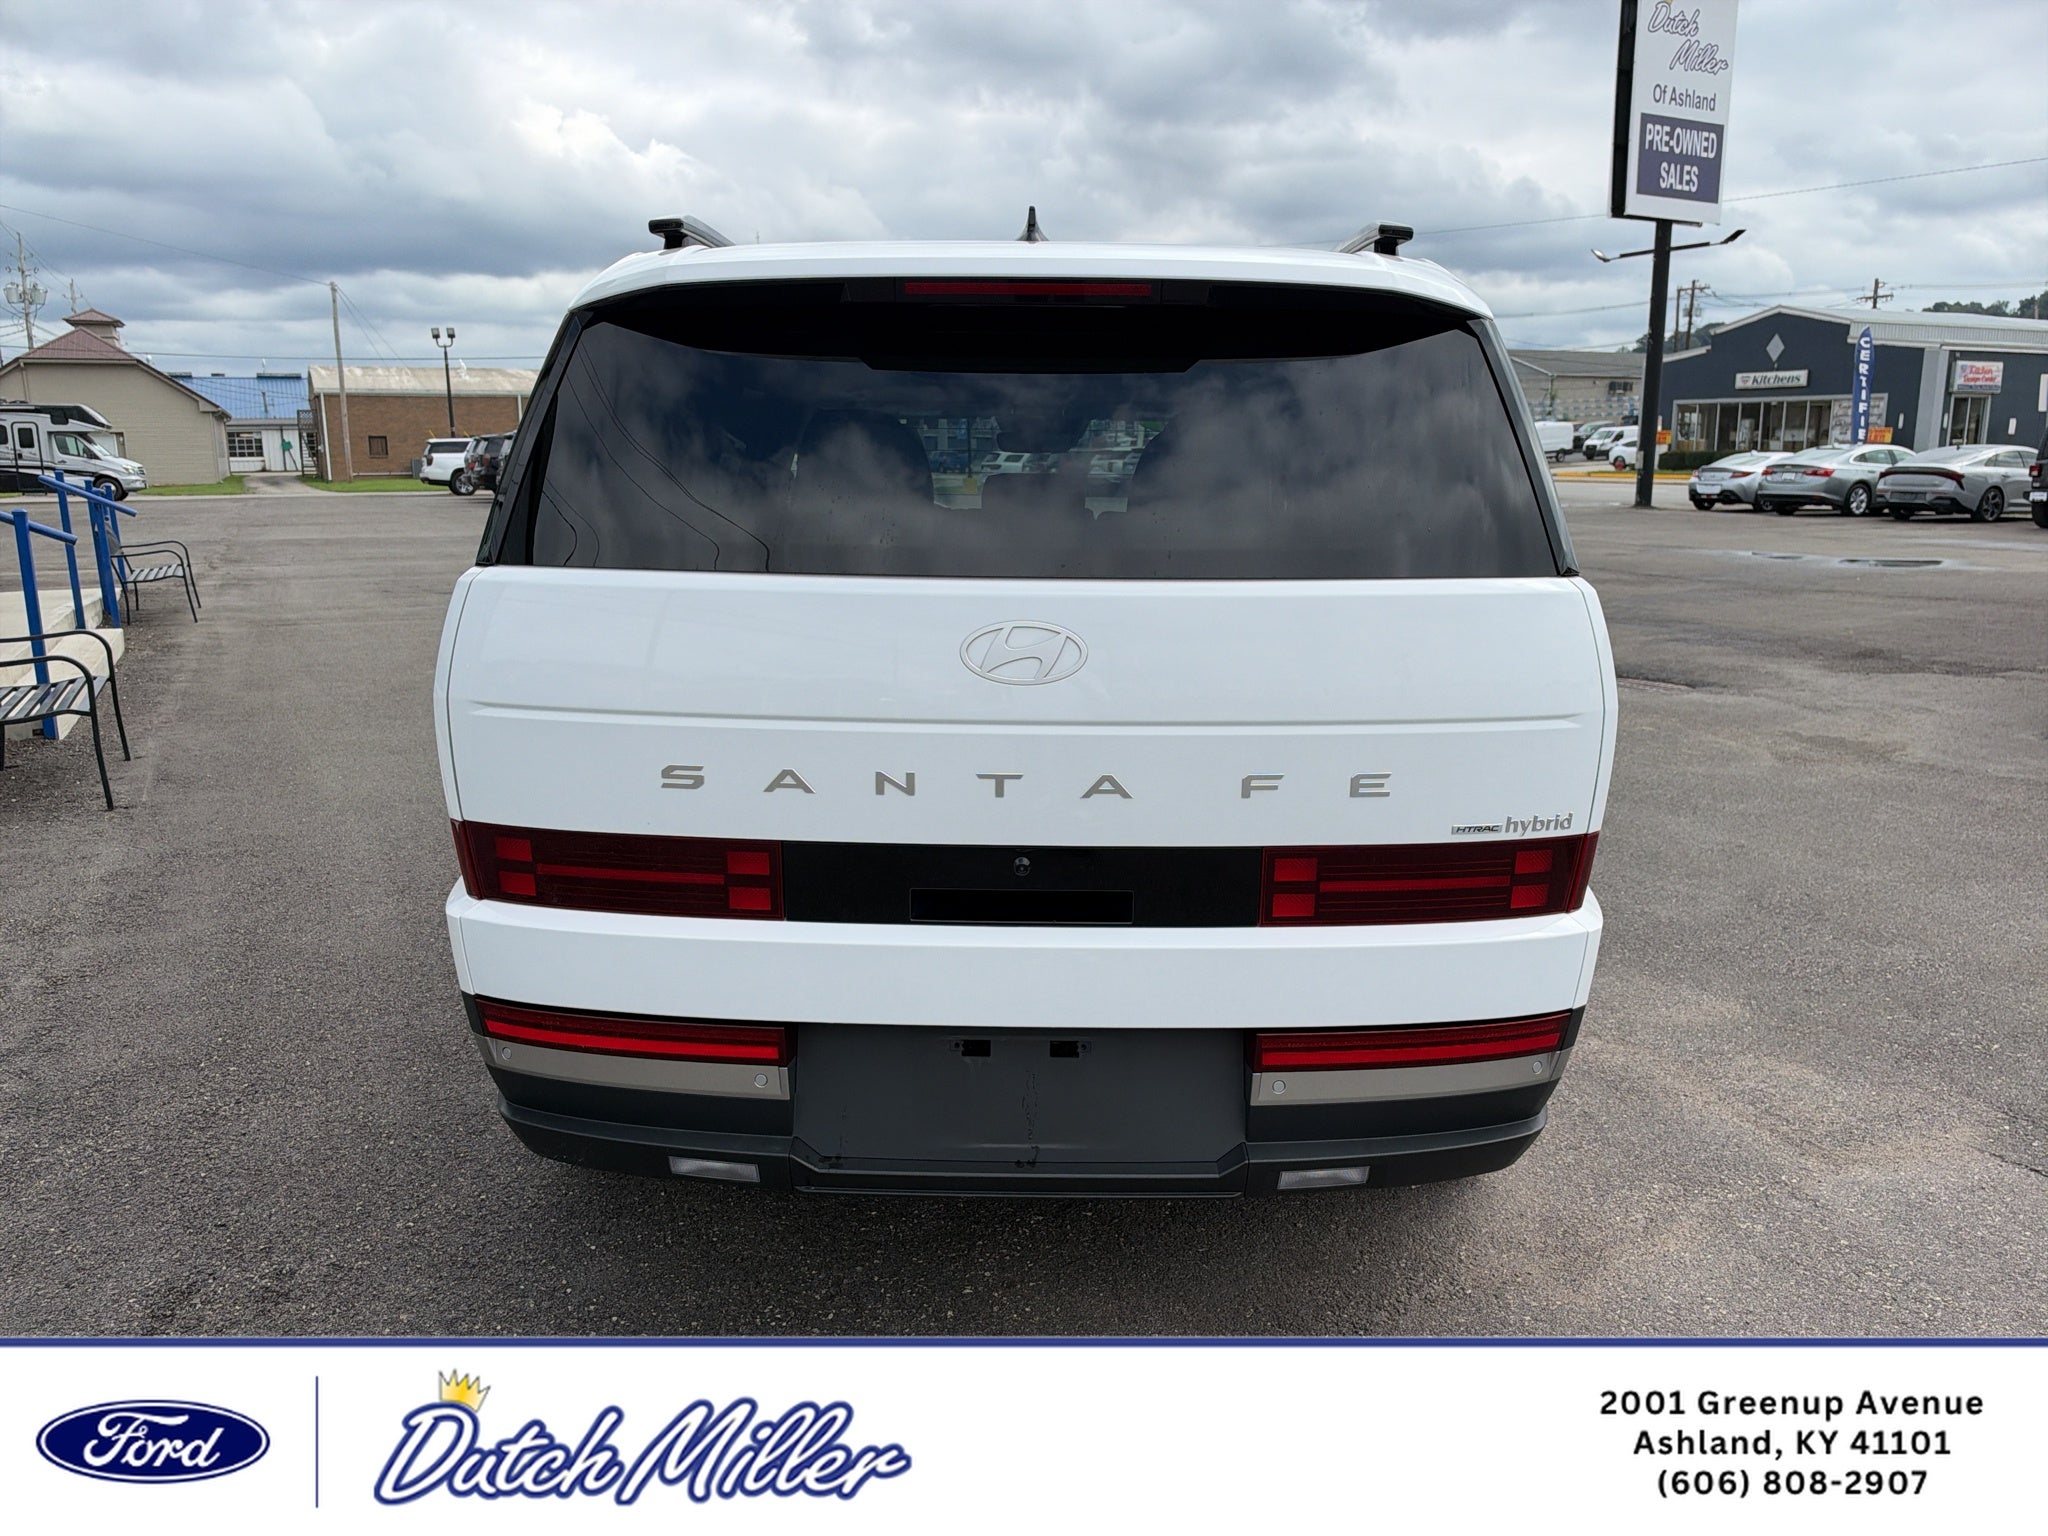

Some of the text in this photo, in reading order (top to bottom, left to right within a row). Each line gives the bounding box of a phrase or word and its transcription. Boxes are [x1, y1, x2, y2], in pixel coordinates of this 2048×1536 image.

[1648, 1, 1700, 37] Dutch
[1669, 39, 1729, 75] Miller
[1653, 84, 1717, 111] Of Ashland
[1645, 123, 1718, 159] PRE-OWNED
[1659, 162, 1699, 193] SALES
[1751, 374, 1801, 386] Kitchens
[660, 763, 1393, 799] SANTA FE
[1456, 812, 1574, 837] HTRAC hybrid
